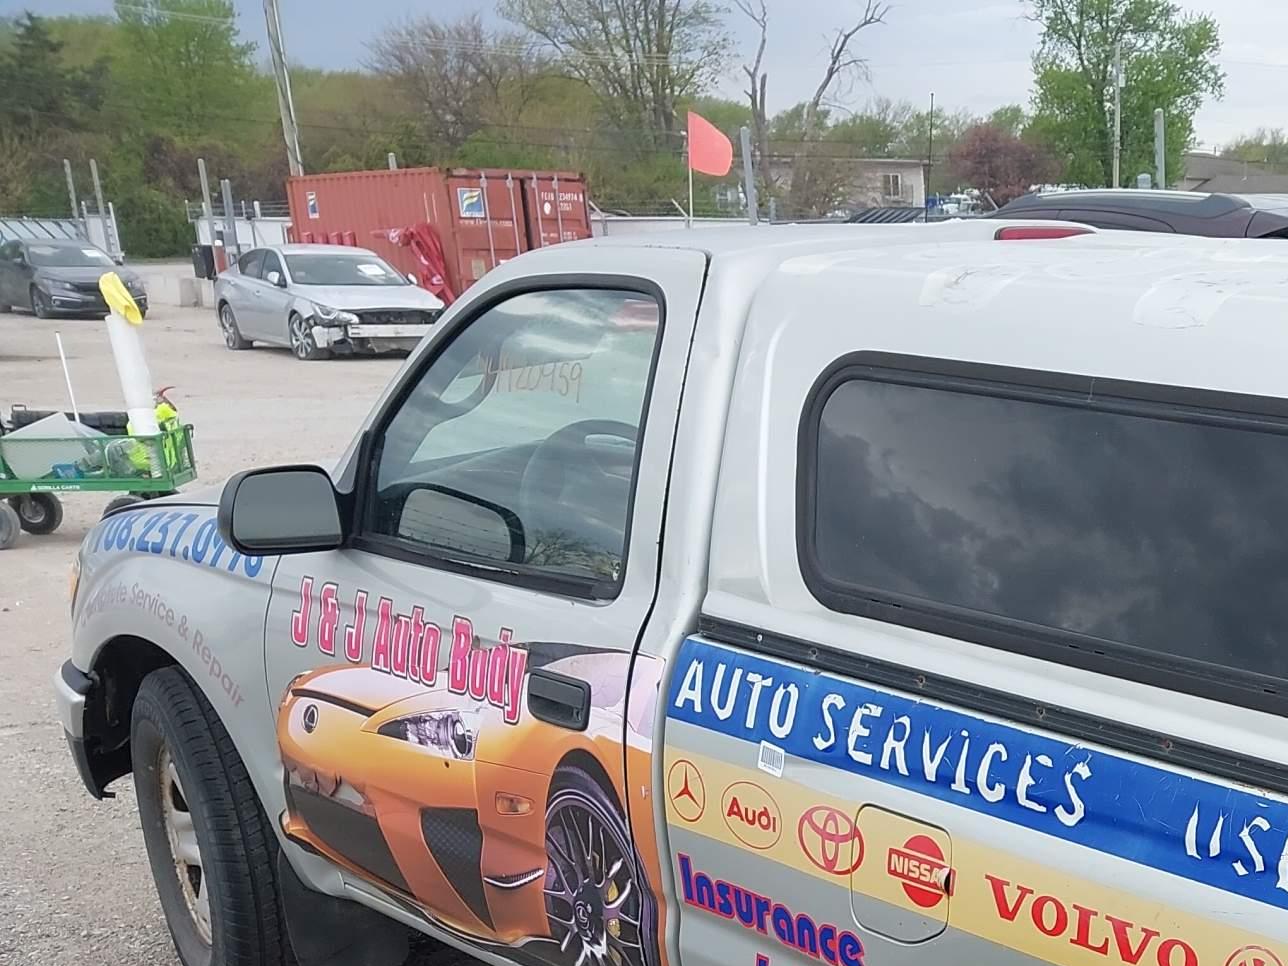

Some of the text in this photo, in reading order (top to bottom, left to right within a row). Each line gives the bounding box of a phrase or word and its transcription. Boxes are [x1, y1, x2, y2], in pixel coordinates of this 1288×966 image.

[129, 582, 176, 627] Service
[178, 615, 189, 641] &
[191, 629, 246, 708] Repair
[292, 576, 529, 726] J & J Auto Body
[674, 658, 799, 740] AUTO
[812, 693, 1093, 828] SERVICES
[890, 853, 947, 891] NISSA
